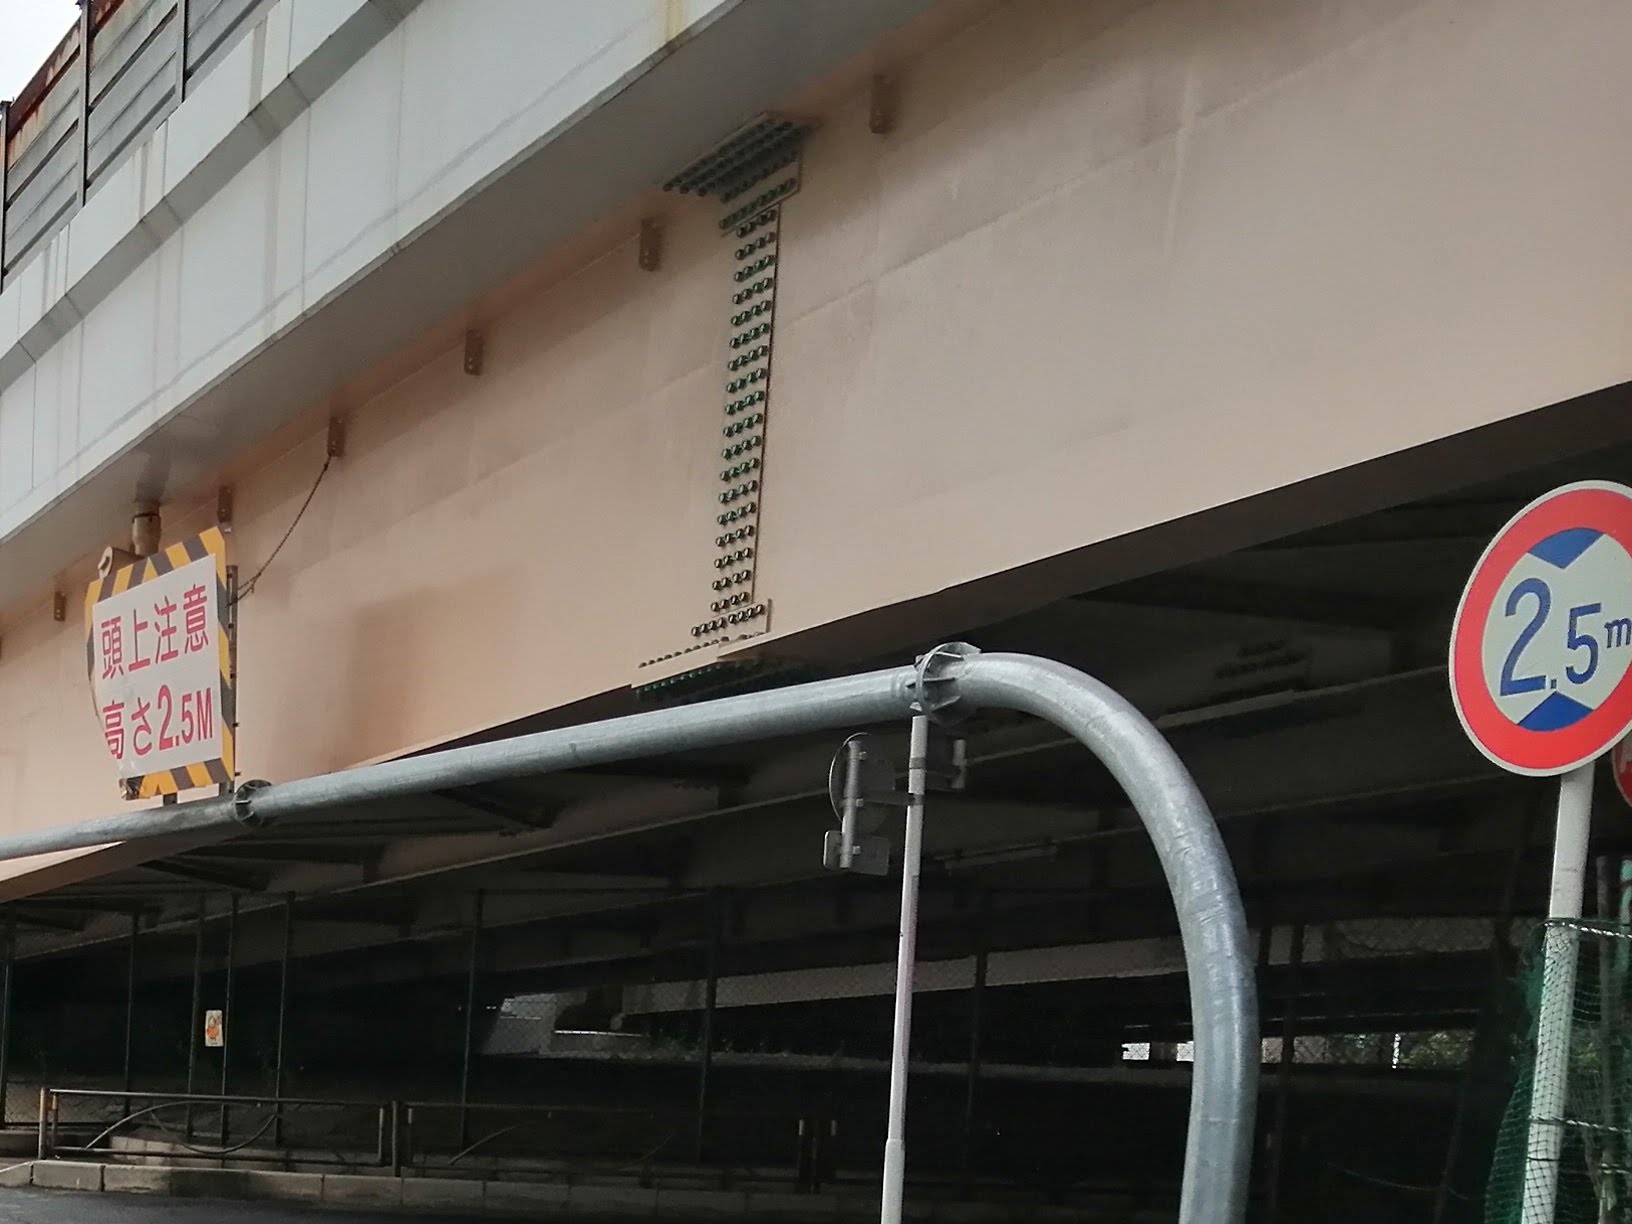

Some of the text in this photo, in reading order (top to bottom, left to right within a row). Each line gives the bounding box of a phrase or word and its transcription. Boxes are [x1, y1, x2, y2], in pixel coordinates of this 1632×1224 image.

[101, 583, 209, 680] 頭上注意
[1500, 577, 1631, 696] 2.5m
[102, 684, 213, 759] 高さ2.5M
